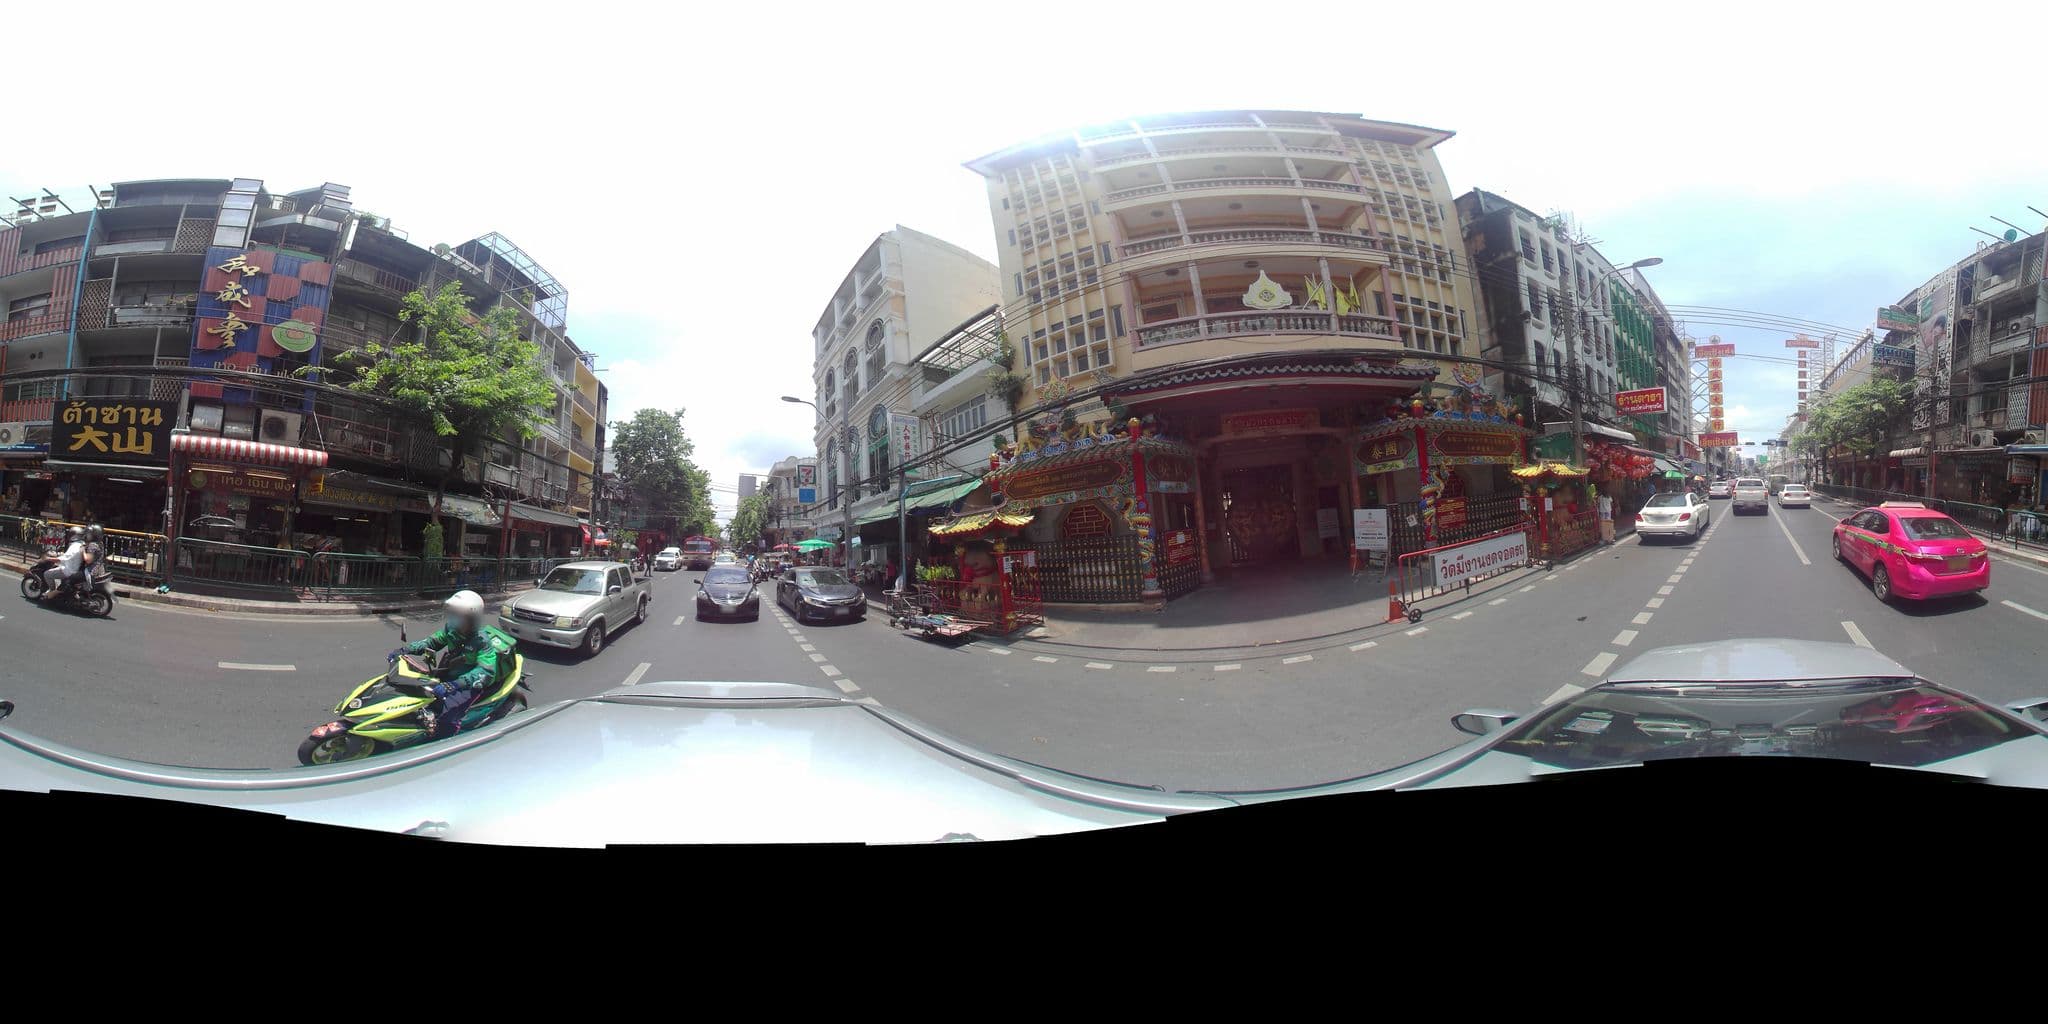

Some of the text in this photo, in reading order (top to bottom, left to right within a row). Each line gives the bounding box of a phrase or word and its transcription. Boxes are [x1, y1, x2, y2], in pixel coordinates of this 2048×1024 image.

[62, 401, 163, 426] ต้าซาน
[69, 425, 153, 455] 大山
